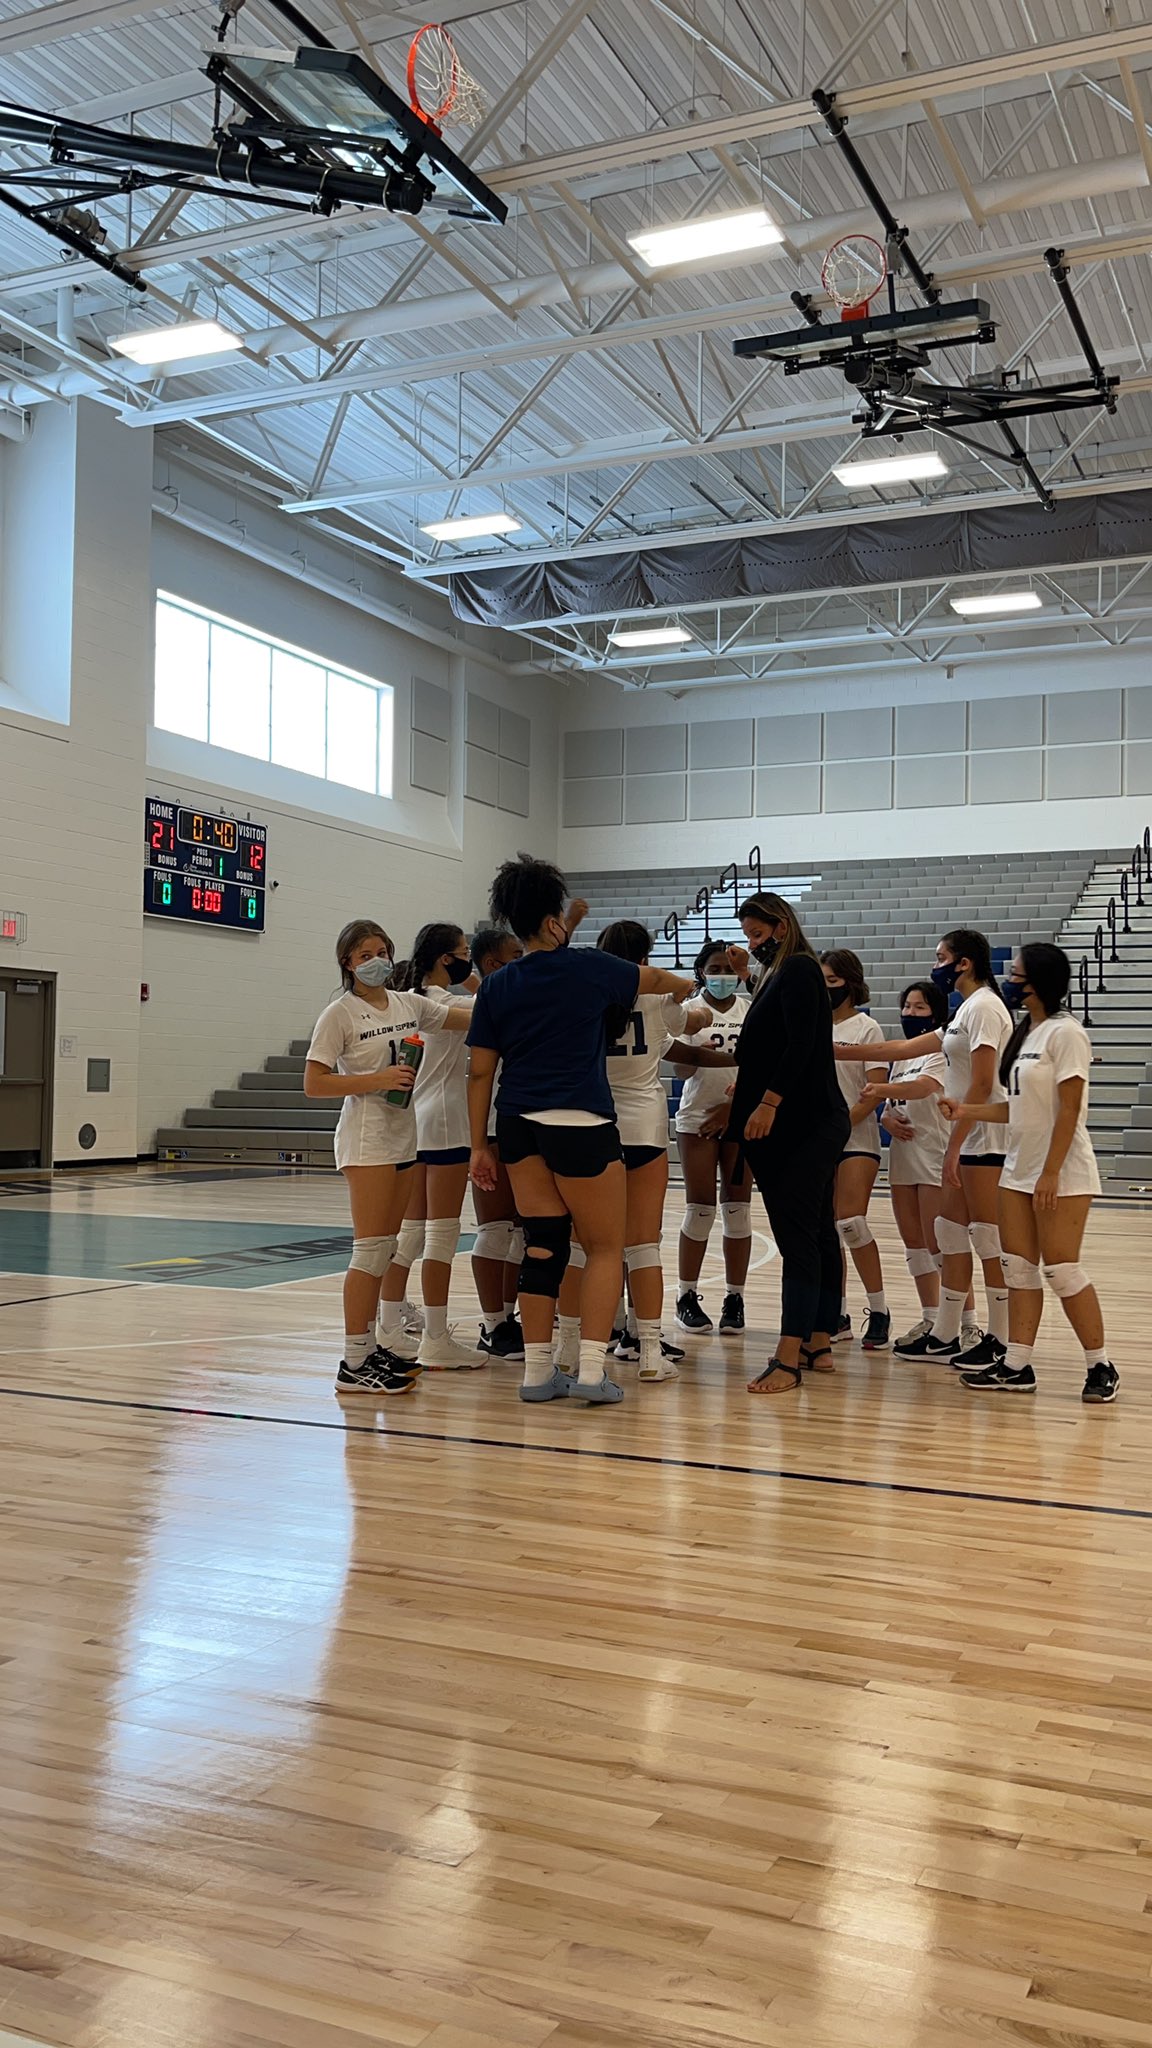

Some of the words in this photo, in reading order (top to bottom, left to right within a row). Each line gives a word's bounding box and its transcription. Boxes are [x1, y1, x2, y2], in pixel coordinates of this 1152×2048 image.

[149, 802, 174, 820] HOME
[152, 820, 174, 850] 21
[193, 815, 234, 848] 0:40
[238, 824, 266, 842] VISITOR
[157, 854, 178, 867] BONUS
[191, 854, 213, 868] PERIOD
[250, 845, 264, 870] 12
[153, 870, 172, 883] FOULS
[183, 876, 201, 889] FOULS
[204, 880, 225, 893] PLAYER
[236, 870, 254, 882] BONUS
[162, 883, 171, 905] 0
[192, 888, 221, 913] 0:00
[240, 887, 257, 899] FOULS
[248, 898, 256, 919] 0
[359, 1026, 394, 1041] WILLOW
[395, 1020, 417, 1032] SPRNG
